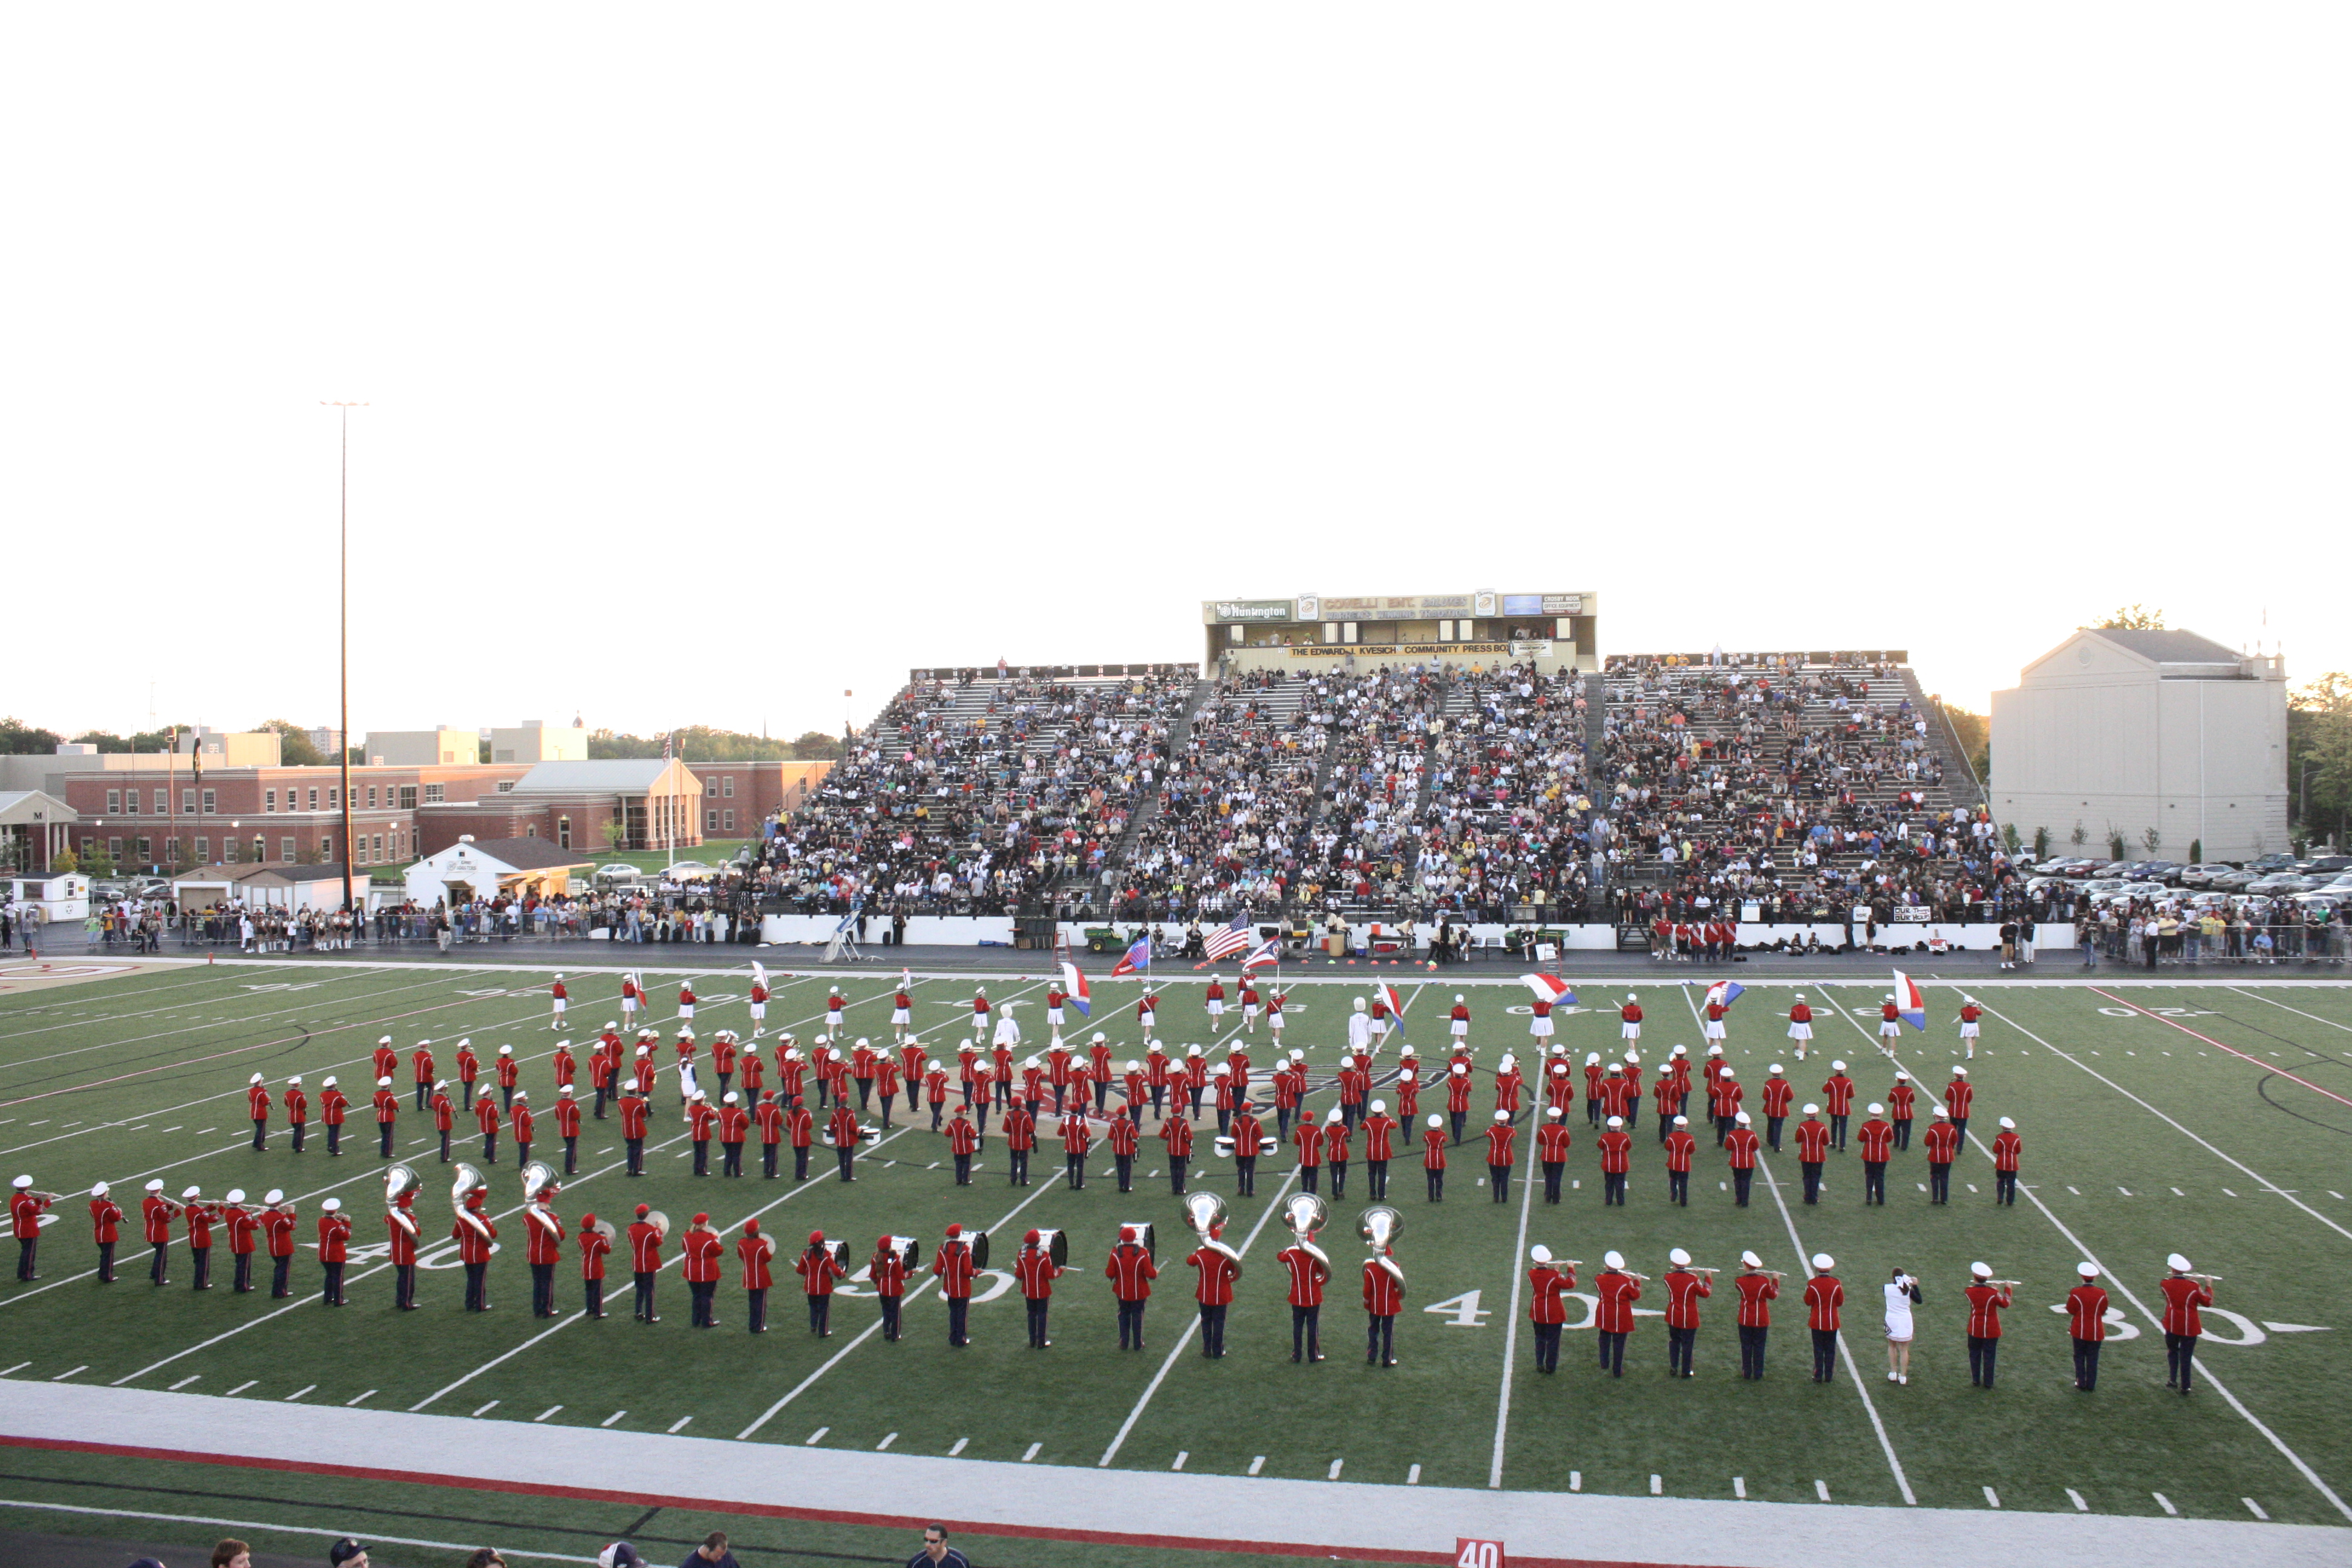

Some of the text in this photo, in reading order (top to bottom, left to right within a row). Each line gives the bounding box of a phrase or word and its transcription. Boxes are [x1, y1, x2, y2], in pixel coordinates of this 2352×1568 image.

[1324, 598, 1378, 609] COVELLI
[1388, 597, 1416, 607] ENT.
[1422, 597, 1468, 607] SALUTES
[1232, 606, 1285, 618] Huntington
[1325, 609, 1468, 619] WARREN'S WINNING TRADITION
[1405, 645, 1459, 654] COMMUNITY
[1458, 1542, 1498, 1568] 40
